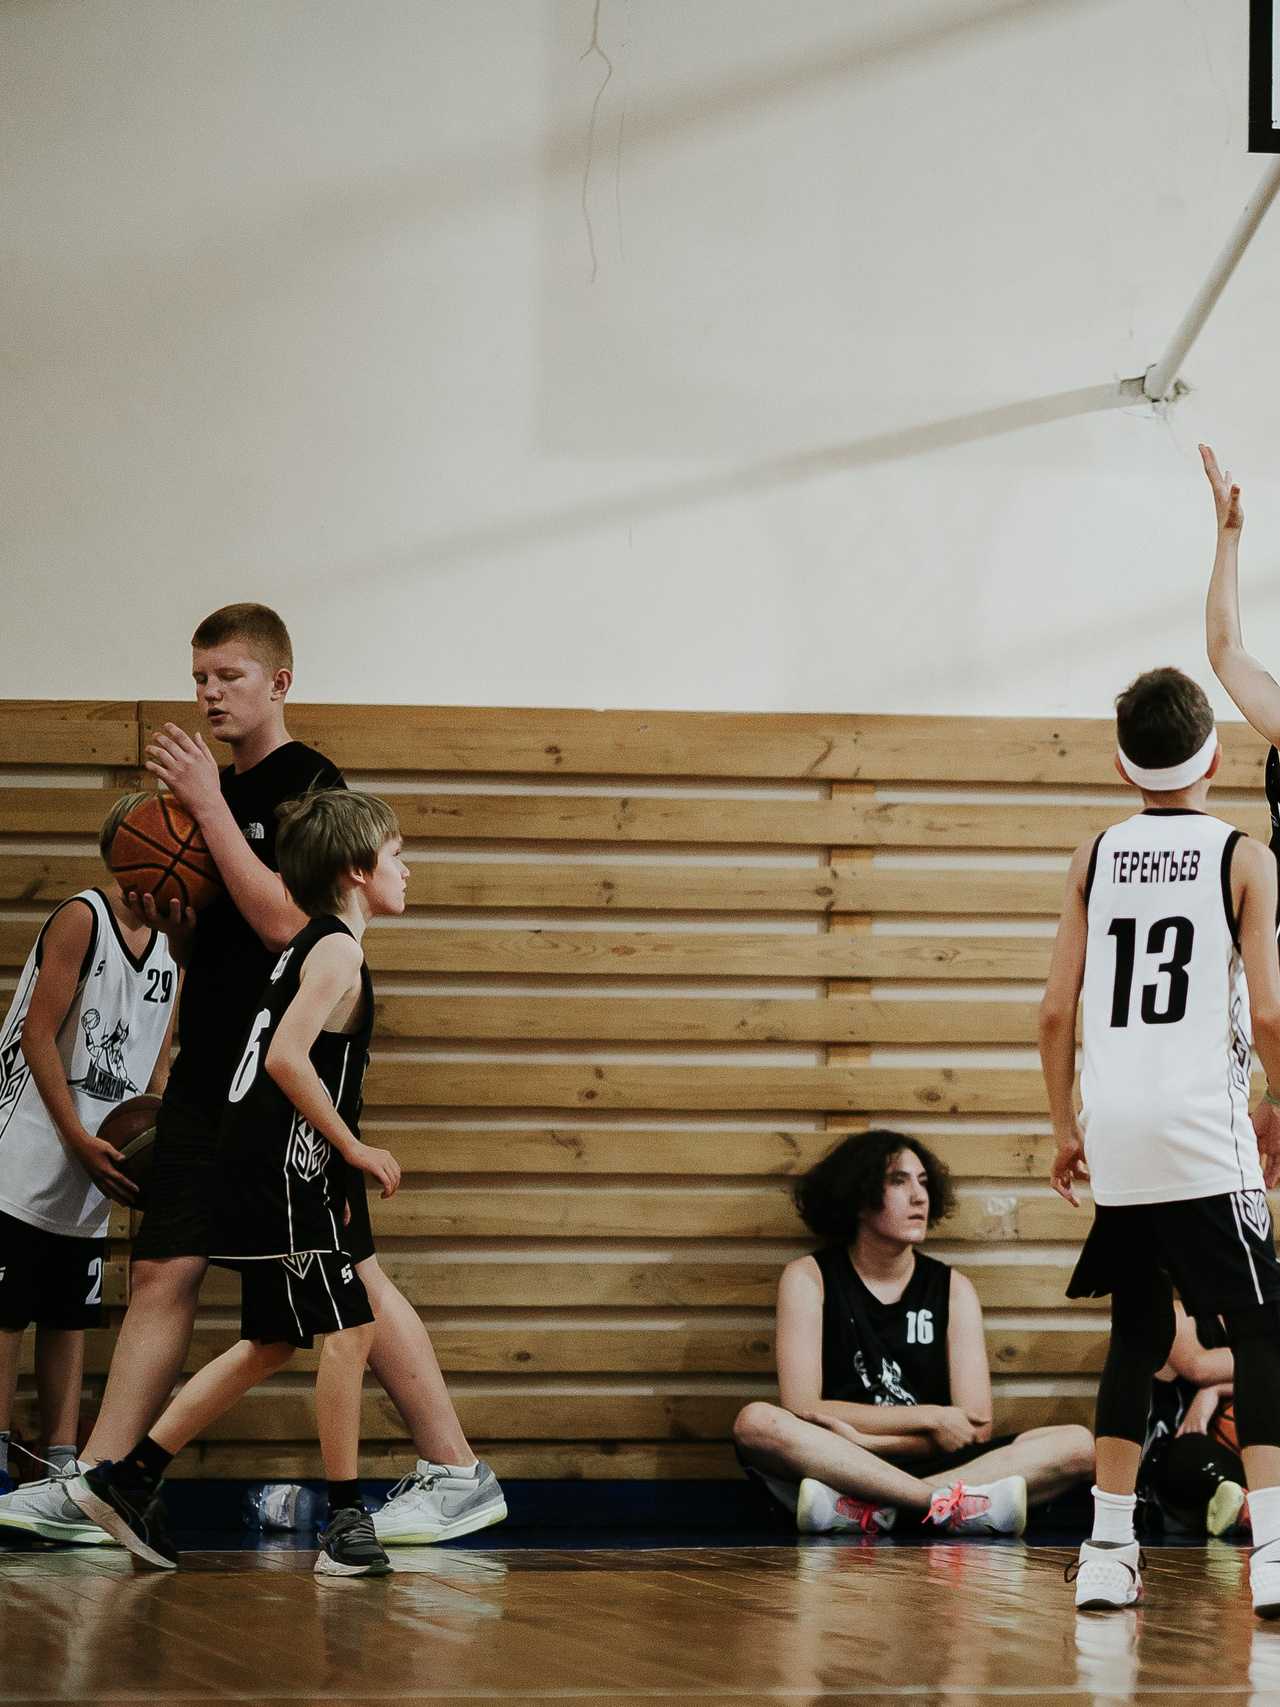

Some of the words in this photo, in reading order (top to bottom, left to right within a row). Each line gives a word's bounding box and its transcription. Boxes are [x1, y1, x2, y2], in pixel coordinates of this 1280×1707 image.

[1113, 850, 1200, 884] ТЕРЕНТЬЕВ
[143, 968, 172, 1003] 29
[1107, 915, 1195, 1028] 13
[228, 1008, 271, 1102] 6
[906, 1308, 934, 1345] 16
